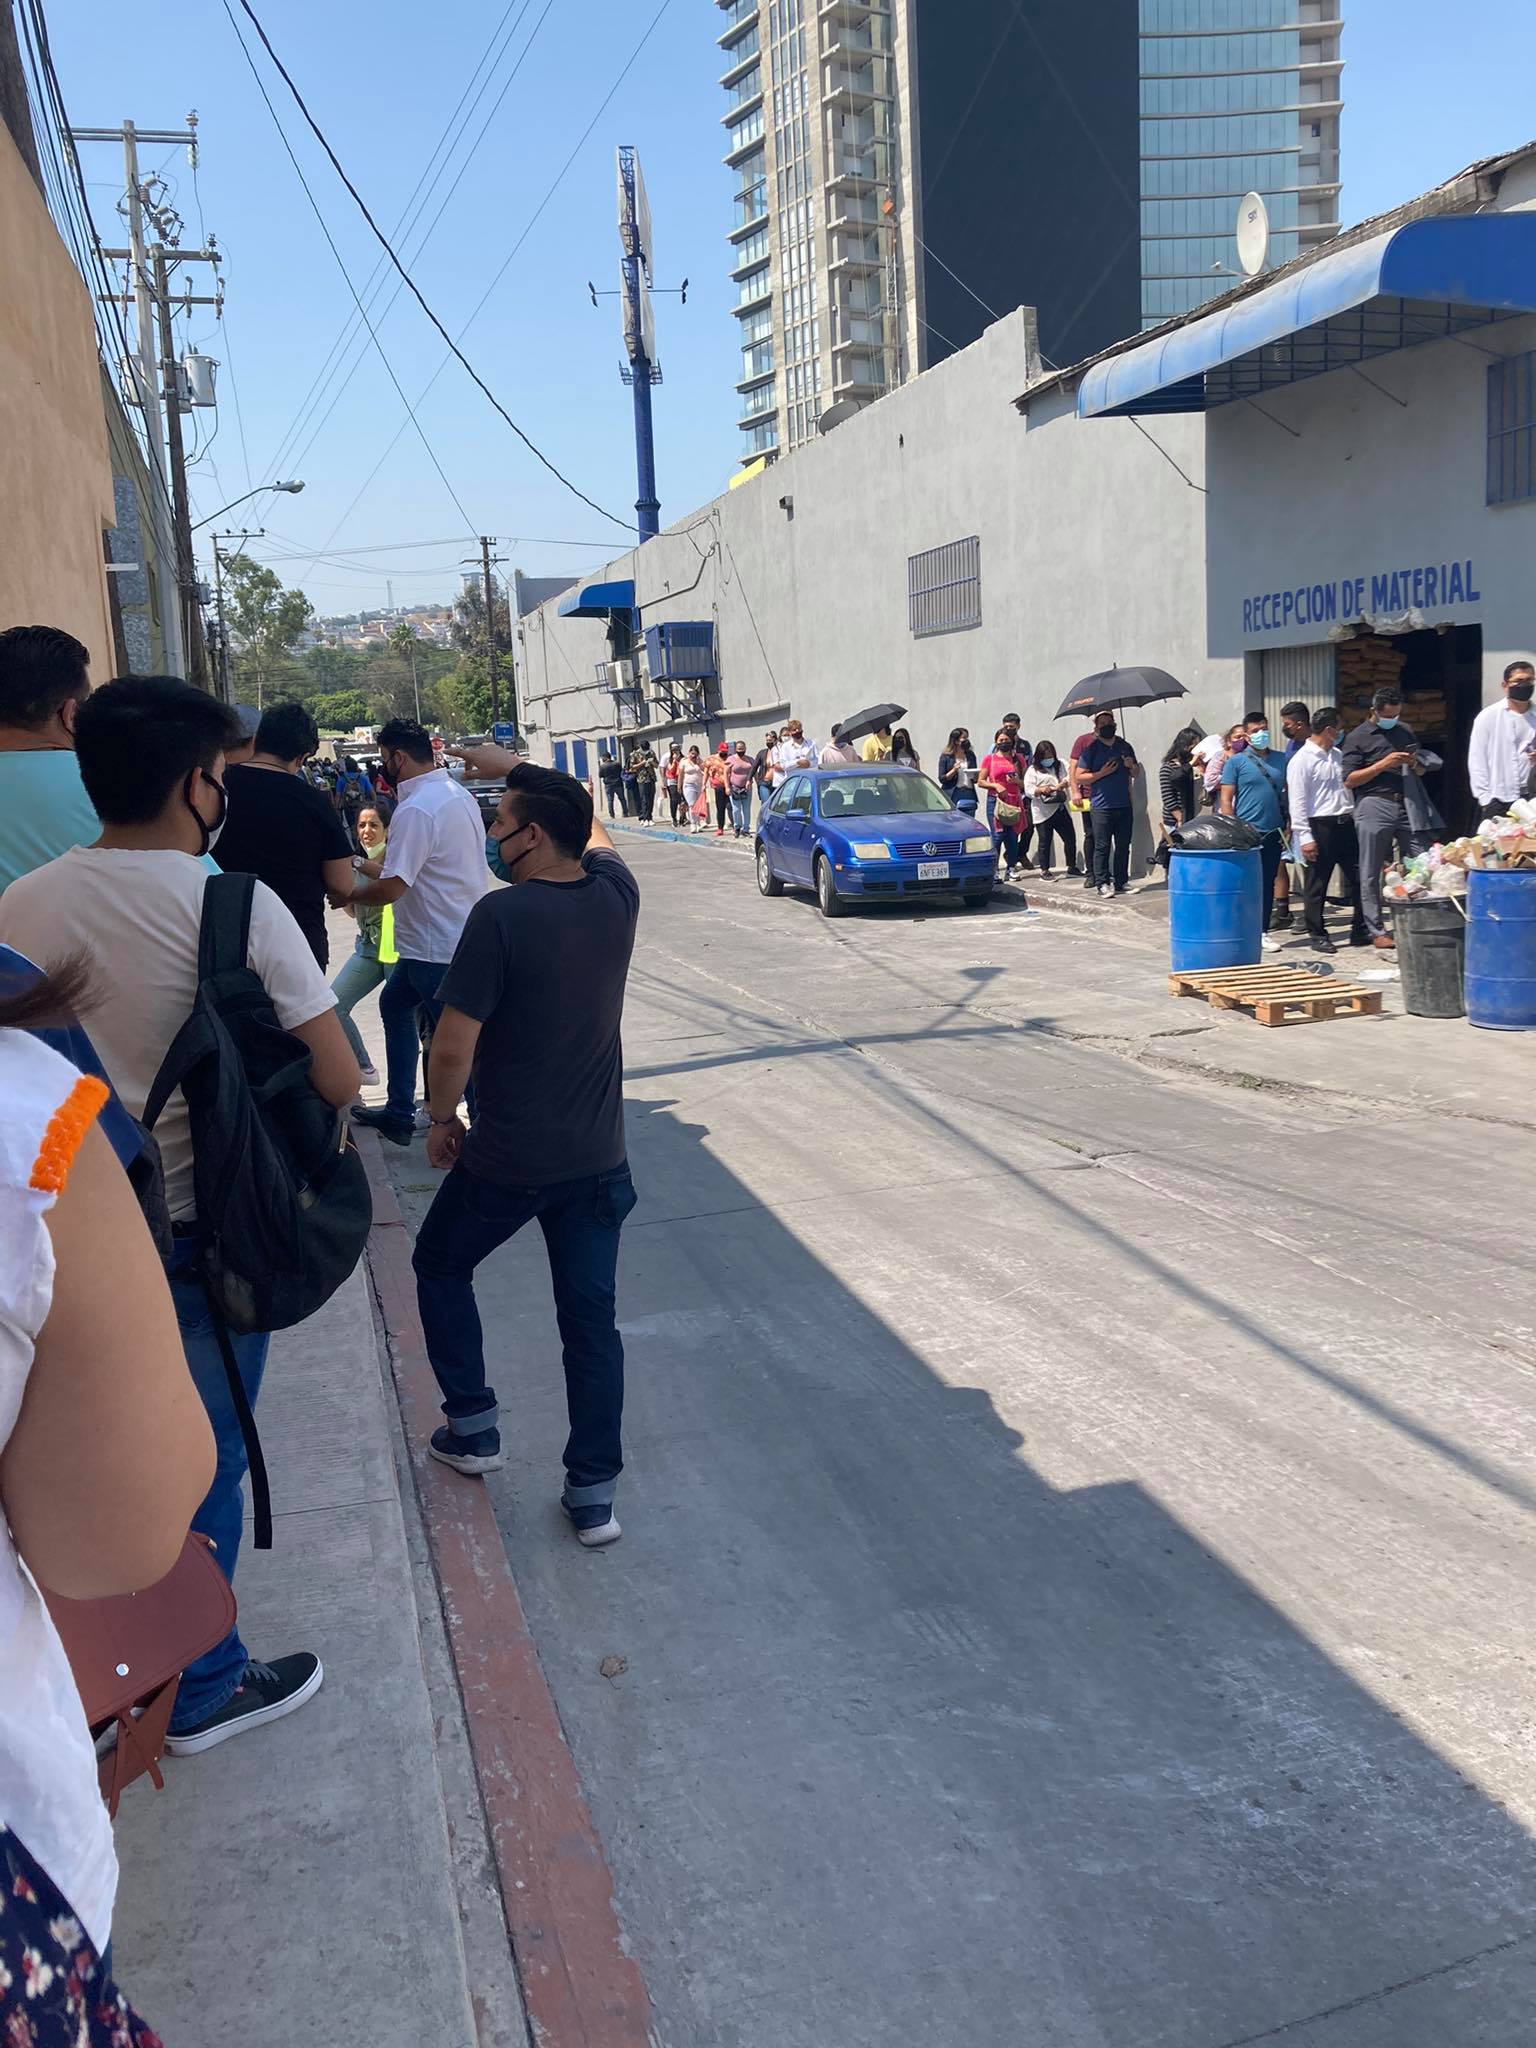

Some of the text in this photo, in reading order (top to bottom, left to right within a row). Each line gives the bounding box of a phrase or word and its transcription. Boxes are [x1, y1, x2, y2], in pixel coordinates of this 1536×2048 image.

[1243, 560, 1481, 633] RECEPCION DE MATERIAL
